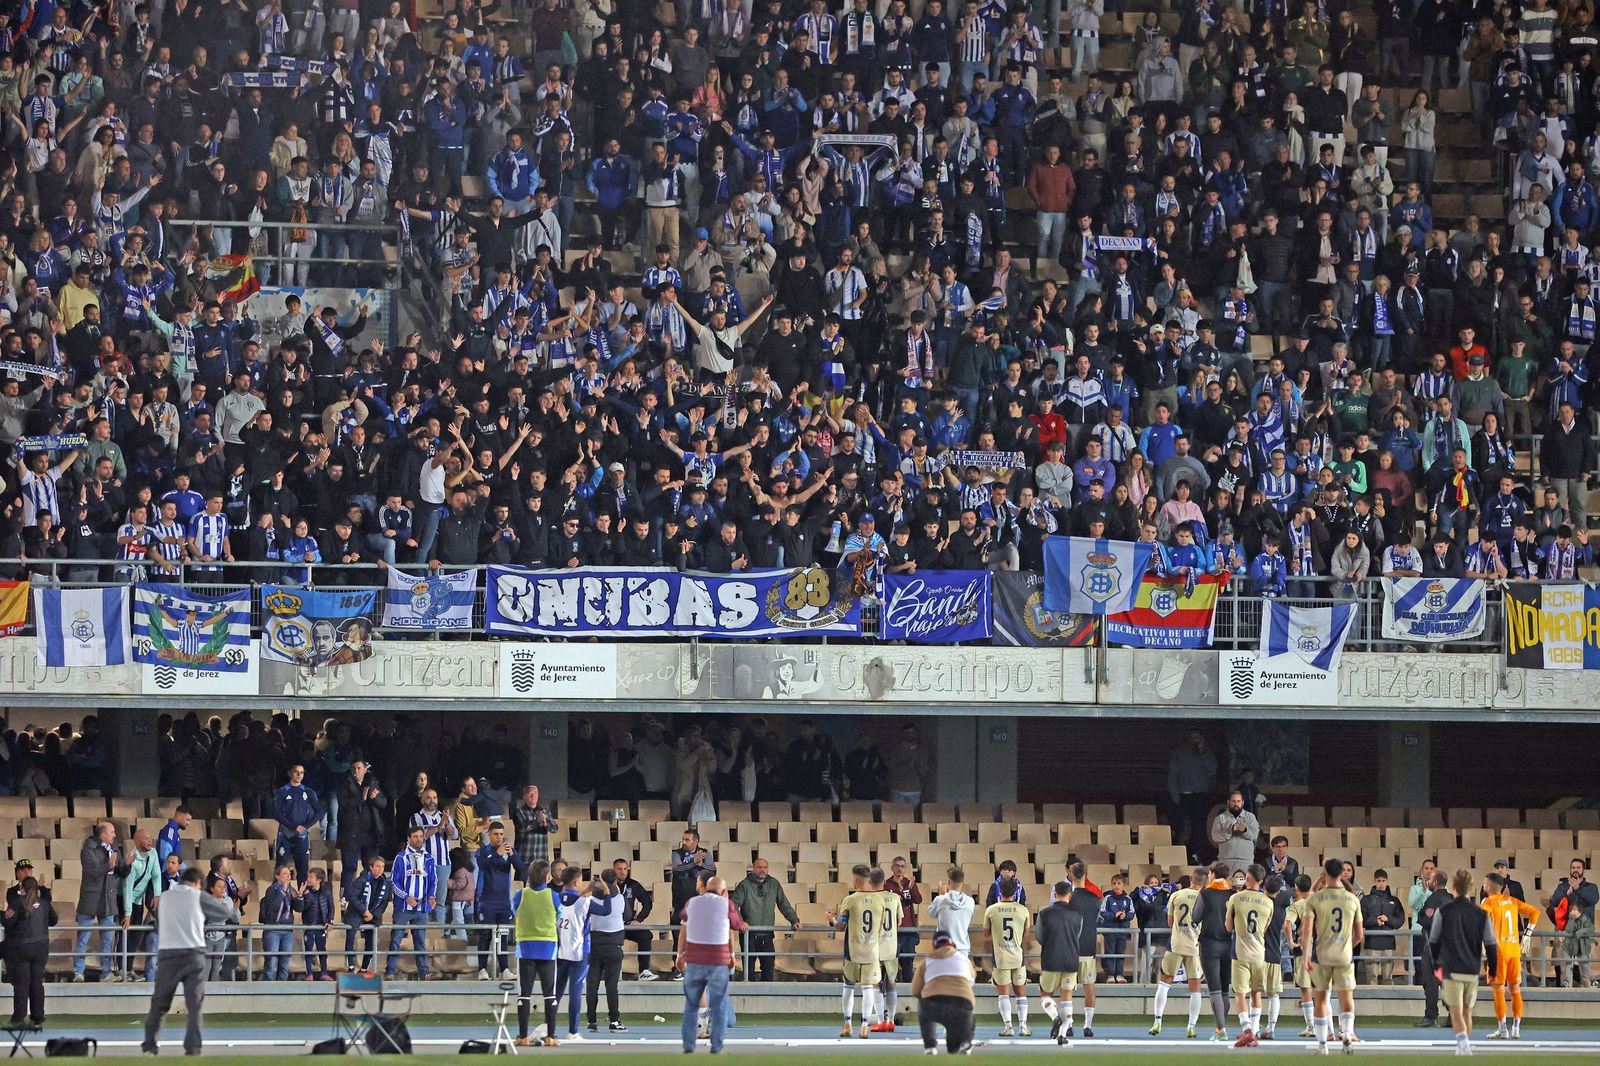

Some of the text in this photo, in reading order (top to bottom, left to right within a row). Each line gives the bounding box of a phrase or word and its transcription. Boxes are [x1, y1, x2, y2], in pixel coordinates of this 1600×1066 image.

[1101, 238, 1140, 247] DECANO
[60, 437, 88, 446] HUELVA
[339, 593, 372, 609] 1889
[497, 574, 760, 629] ONUBAS
[1542, 591, 1583, 607] RCRH
[390, 616, 469, 627] HOOLIGANS
[1411, 620, 1469, 634] DE HUELVA
[1108, 622, 1166, 637] RECREATIVO
[1168, 629, 1181, 638] DE
[137, 639, 152, 656] 18
[1144, 636, 1181, 646] DECANO
[224, 648, 246, 667] 89
[1548, 647, 1584, 663] 1889
[182, 669, 220, 680] de Jerez
[540, 663, 606, 675] Ayuntamiento
[1259, 670, 1327, 682] Ayuntamiento
[540, 673, 577, 684] de Jerez
[1259, 680, 1297, 690] de Jerez
[544, 728, 558, 737] 140
[1404, 736, 1418, 745] 139
[862, 909, 873, 934] 9
[1178, 903, 1190, 927] 2
[1246, 909, 1258, 935] 6
[1331, 907, 1343, 933] 3
[1504, 909, 1513, 936] 1
[559, 917, 570, 930] 22
[1002, 917, 1014, 941] 5
